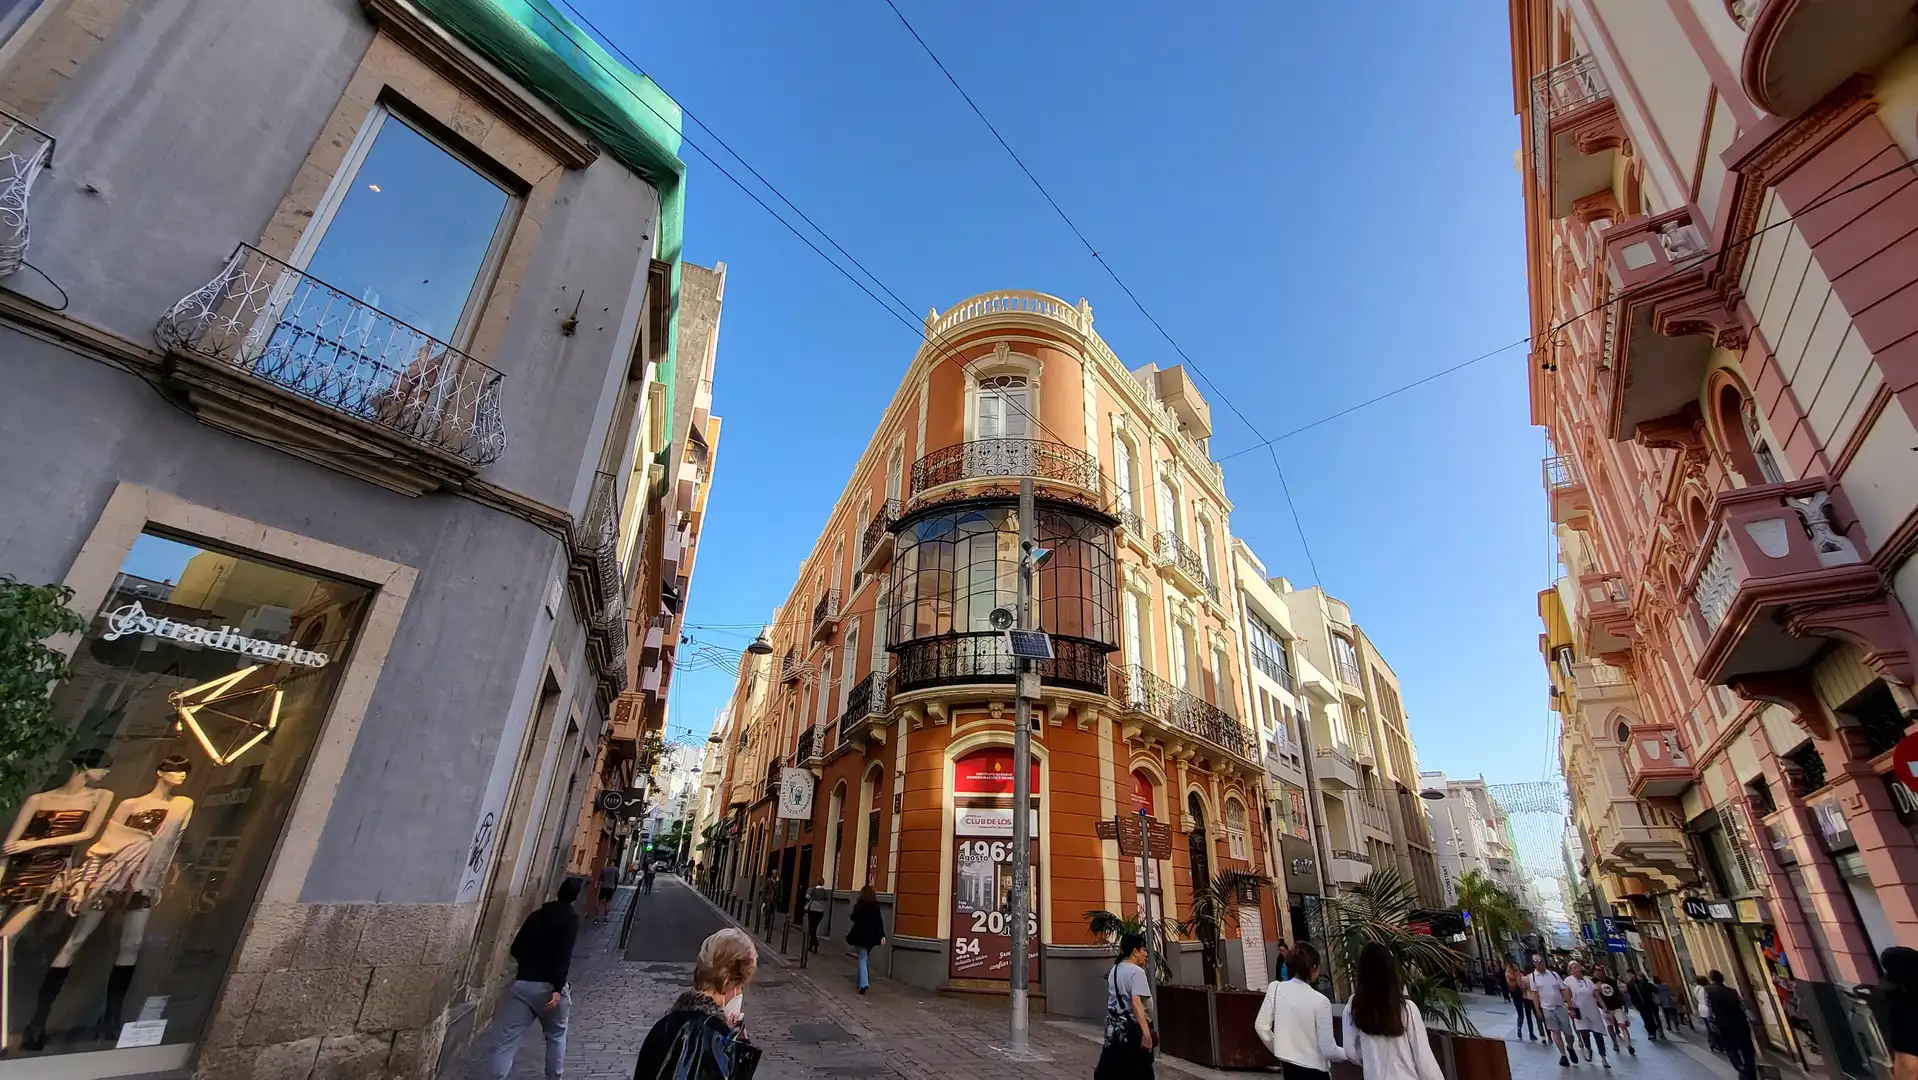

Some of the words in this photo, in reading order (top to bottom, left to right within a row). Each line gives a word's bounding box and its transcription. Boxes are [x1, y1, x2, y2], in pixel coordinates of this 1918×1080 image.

[138, 614, 330, 669] stradivarius
[958, 853, 989, 863] Agosto
[1686, 902, 1707, 915] IN
[955, 937, 981, 955] 54
